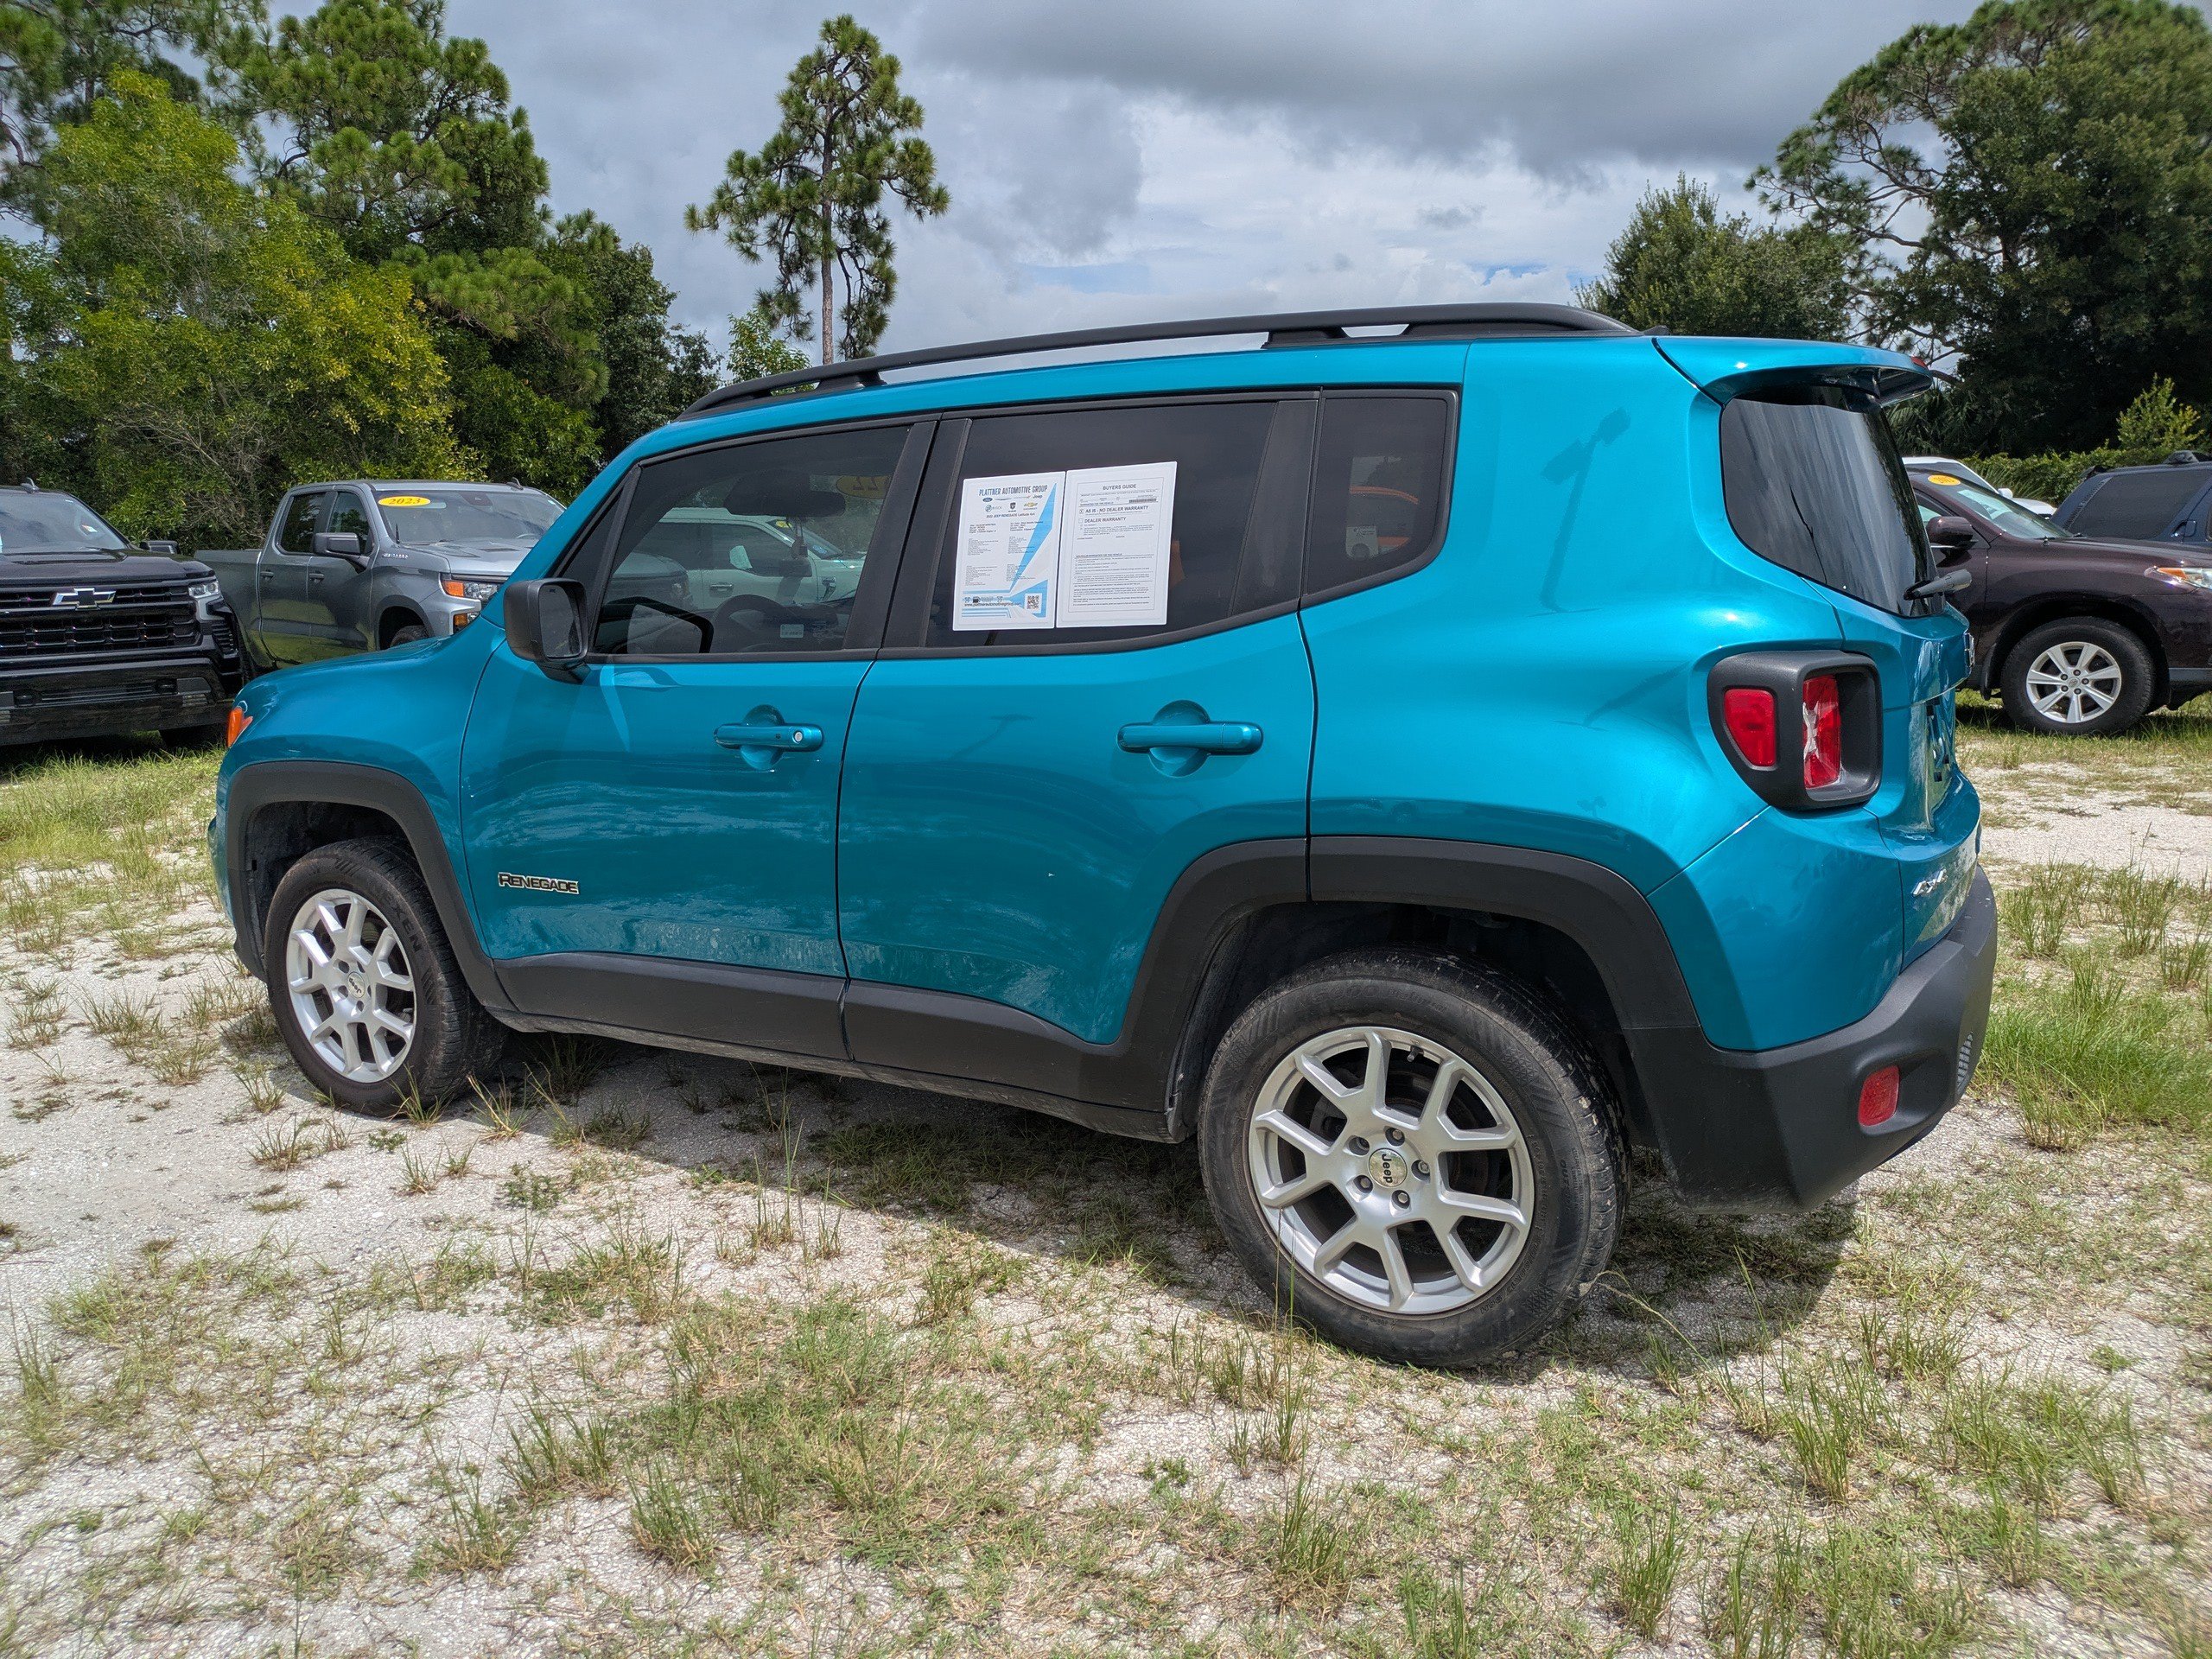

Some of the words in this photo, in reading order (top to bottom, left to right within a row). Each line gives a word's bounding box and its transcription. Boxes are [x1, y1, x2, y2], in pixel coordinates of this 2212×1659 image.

[978, 488, 1001, 497] PLATTNER
[1001, 486, 1031, 495] AUTOMOTIVE
[1032, 485, 1048, 493] GROUP
[498, 872, 580, 894] RENEGADE
[348, 977, 362, 994] Jeep
[1382, 1153, 1393, 1184] Jeep
